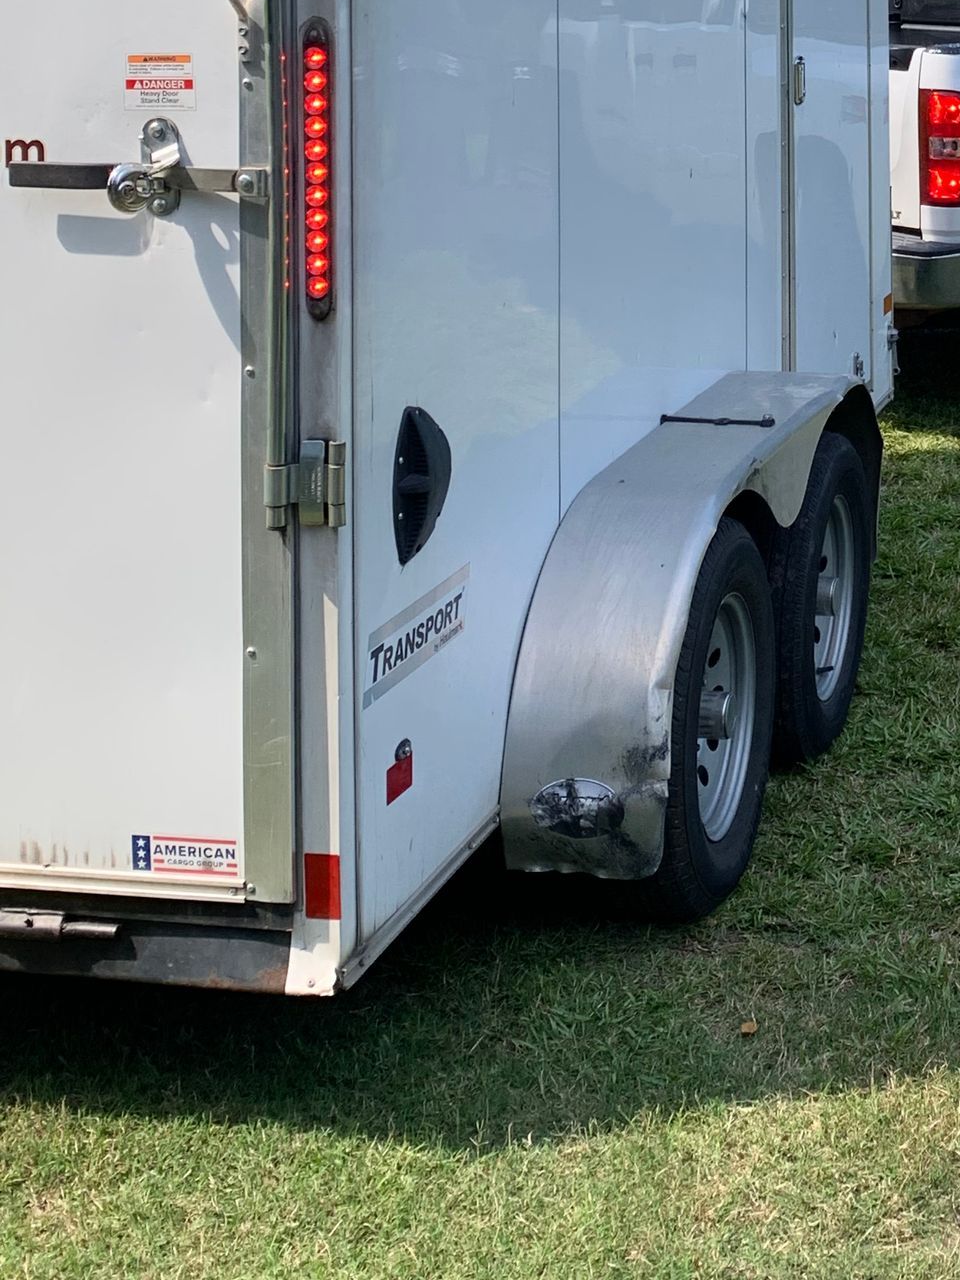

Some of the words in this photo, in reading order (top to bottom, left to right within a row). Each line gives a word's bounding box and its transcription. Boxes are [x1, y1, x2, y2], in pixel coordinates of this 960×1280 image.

[143, 80, 185, 89] DANGER
[370, 592, 463, 684] TRANSPORT
[153, 844, 236, 860] AMERICAN
[167, 858, 194, 866] CARGO
[196, 860, 224, 868] GROUP
